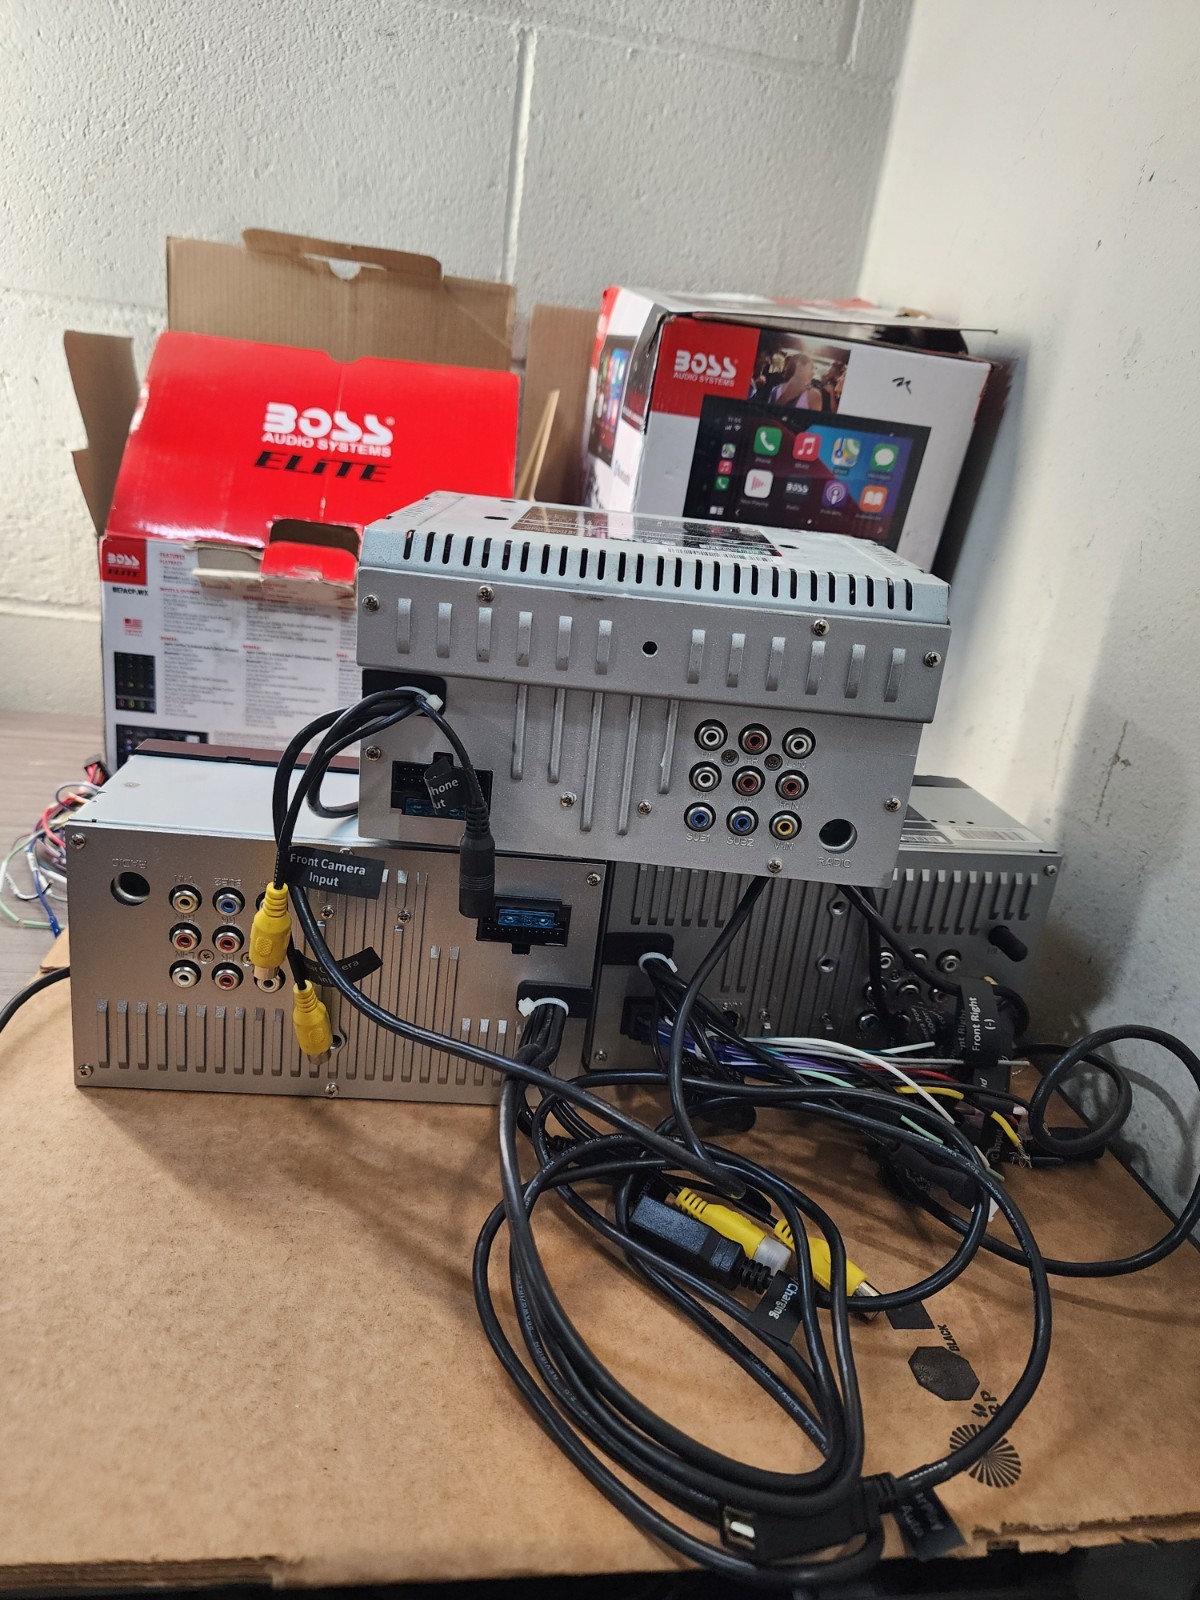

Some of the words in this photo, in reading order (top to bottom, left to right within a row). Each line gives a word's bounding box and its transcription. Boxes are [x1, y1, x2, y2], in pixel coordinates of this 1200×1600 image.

[674, 349, 737, 379] BOSS
[673, 371, 698, 382] AUDIO
[699, 375, 735, 388] SYSTEMS
[263, 401, 394, 446] BOSS
[261, 432, 314, 448] AUDIO
[316, 438, 392, 458] SYSTEMS
[254, 450, 392, 483] ELITE
[786, 481, 809, 493] BOSS
[107, 552, 141, 567] BOSS
[686, 832, 711, 843] SUB1
[726, 836, 755, 847] SUB2
[290, 853, 319, 868] Front
[320, 858, 367, 876] Camera
[817, 857, 852, 868] RADIO
[309, 871, 339, 887] Input
[968, 996, 981, 1021] Right
[984, 1018, 996, 1030] (-)
[971, 1023, 981, 1051] Front
